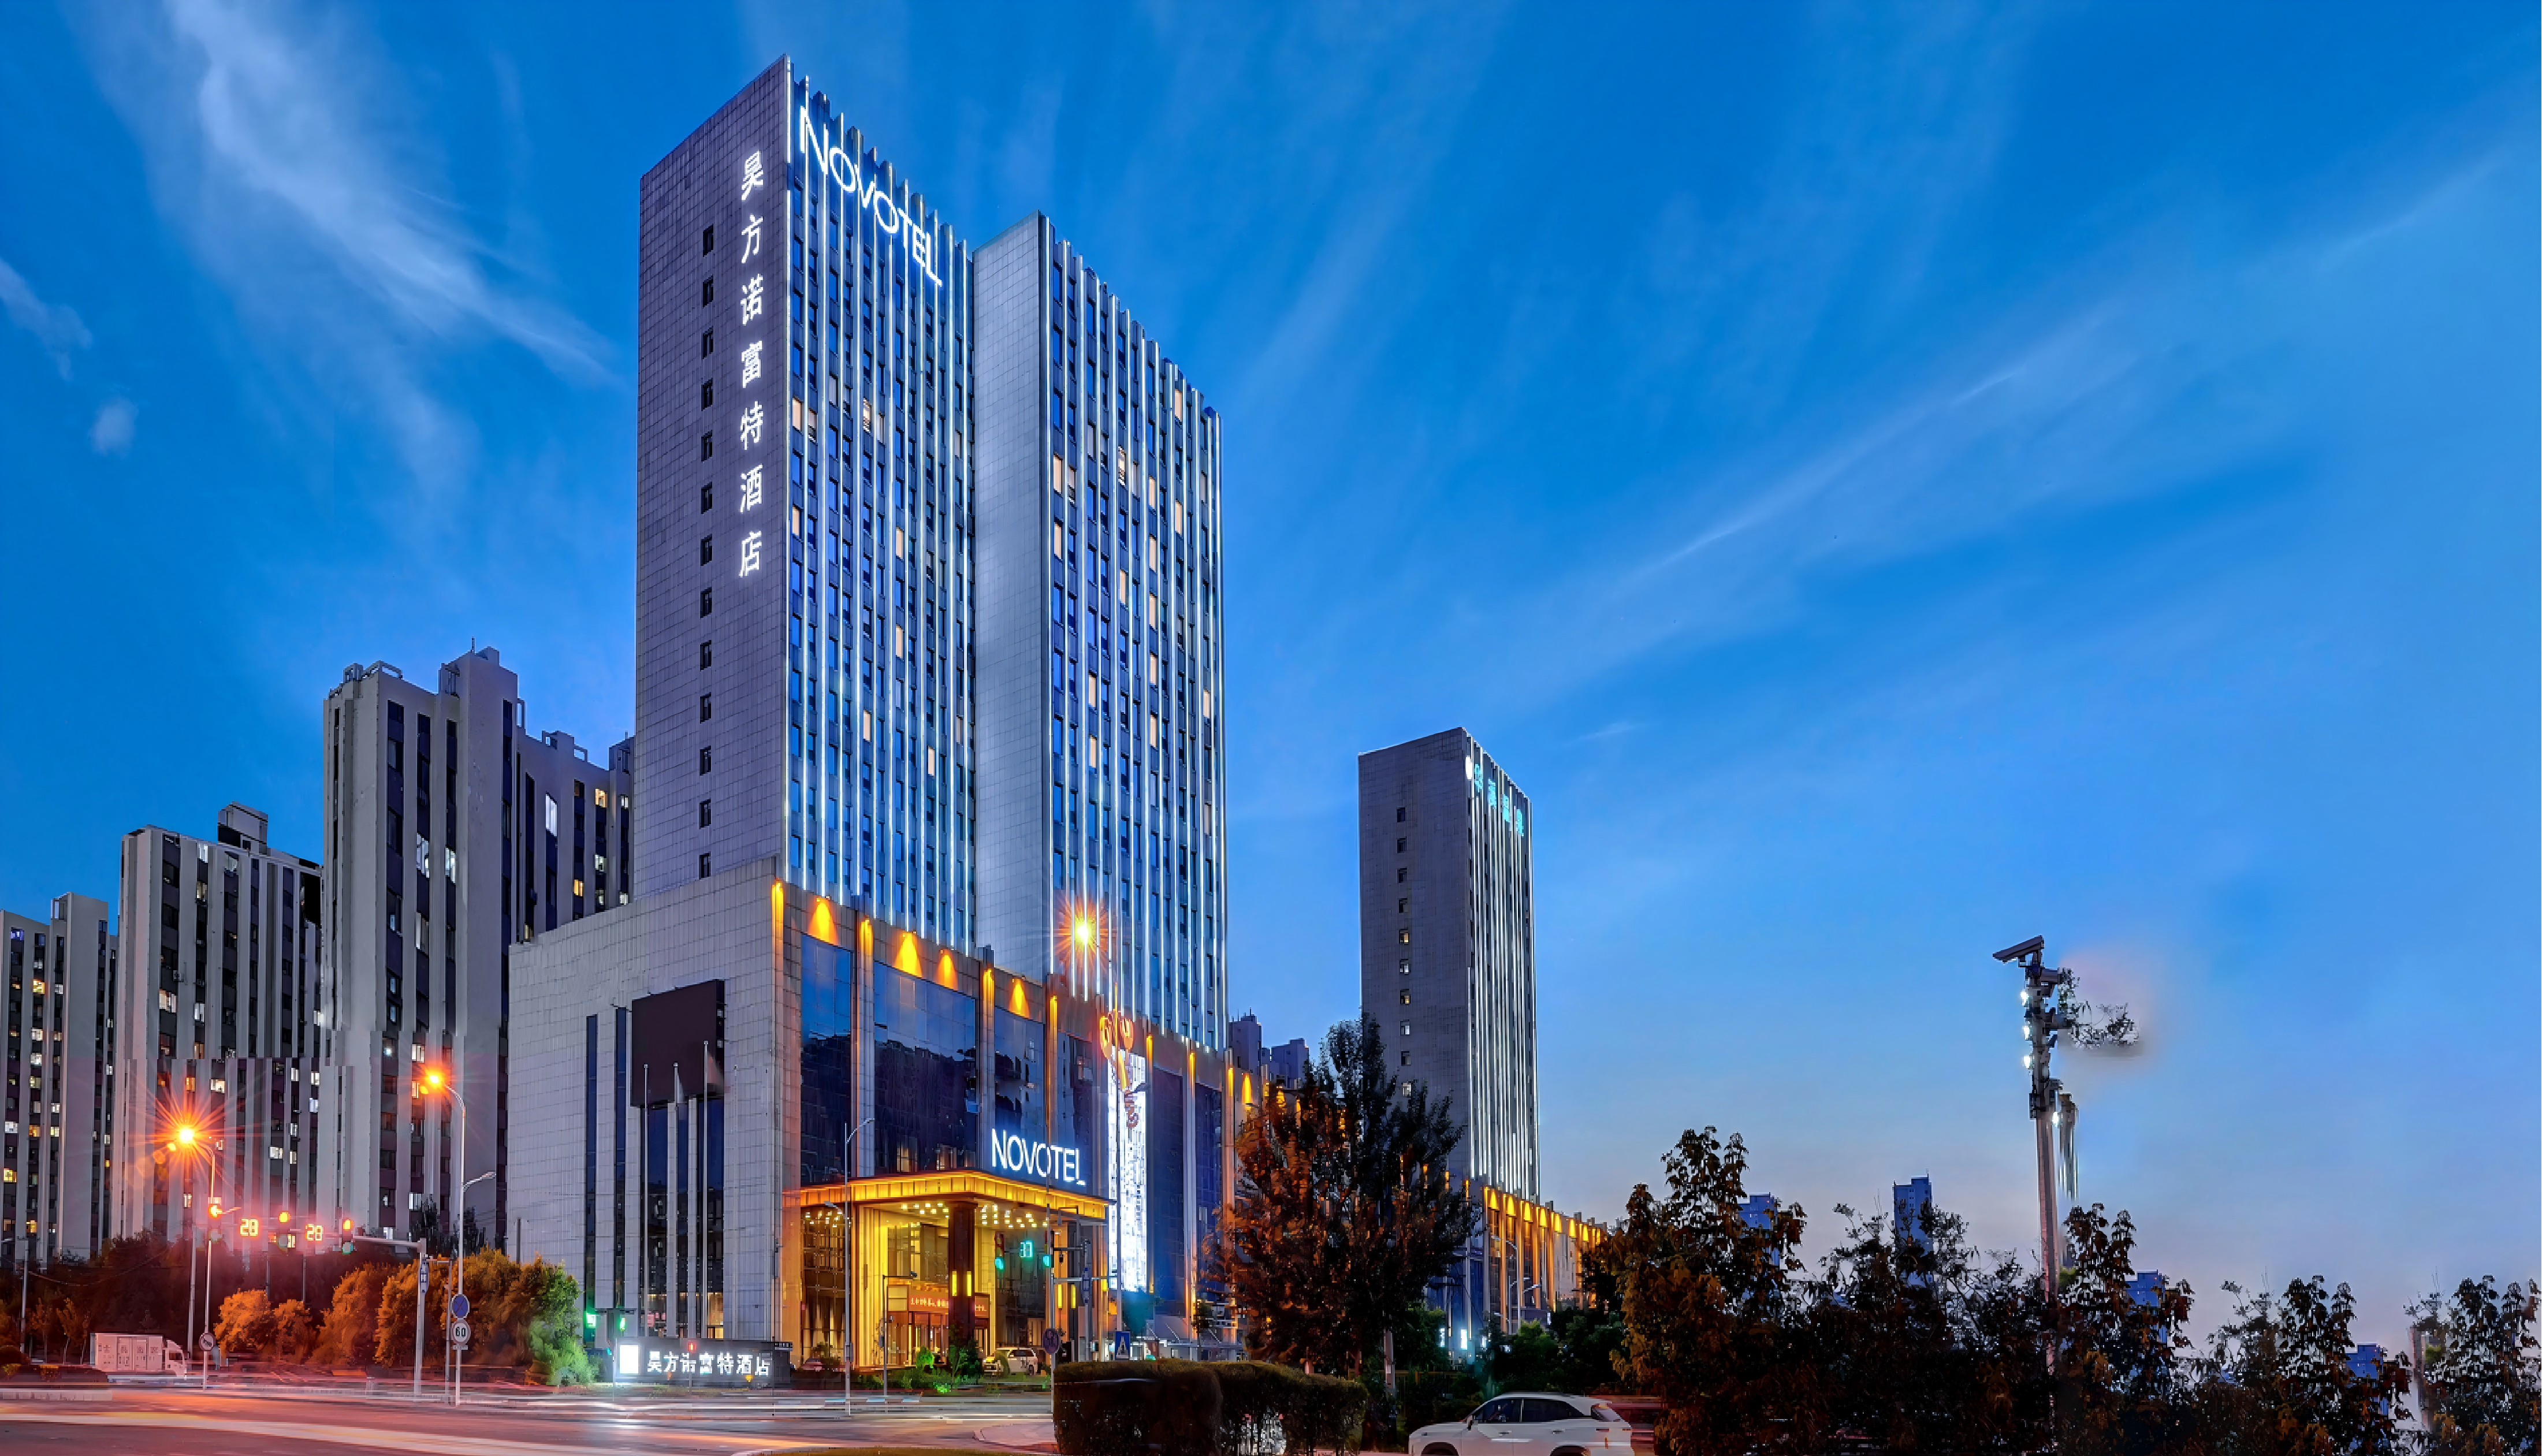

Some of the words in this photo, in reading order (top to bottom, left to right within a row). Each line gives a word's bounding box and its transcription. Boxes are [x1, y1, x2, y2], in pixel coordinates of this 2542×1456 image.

[799, 105, 943, 288] NOVOTEL
[739, 149, 764, 578] 昊方诺富特酒店
[992, 1128, 1086, 1186] NOVOTEL
[240, 1219, 258, 1236] 28
[306, 1224, 323, 1241] 28
[455, 1327, 466, 1337] 60
